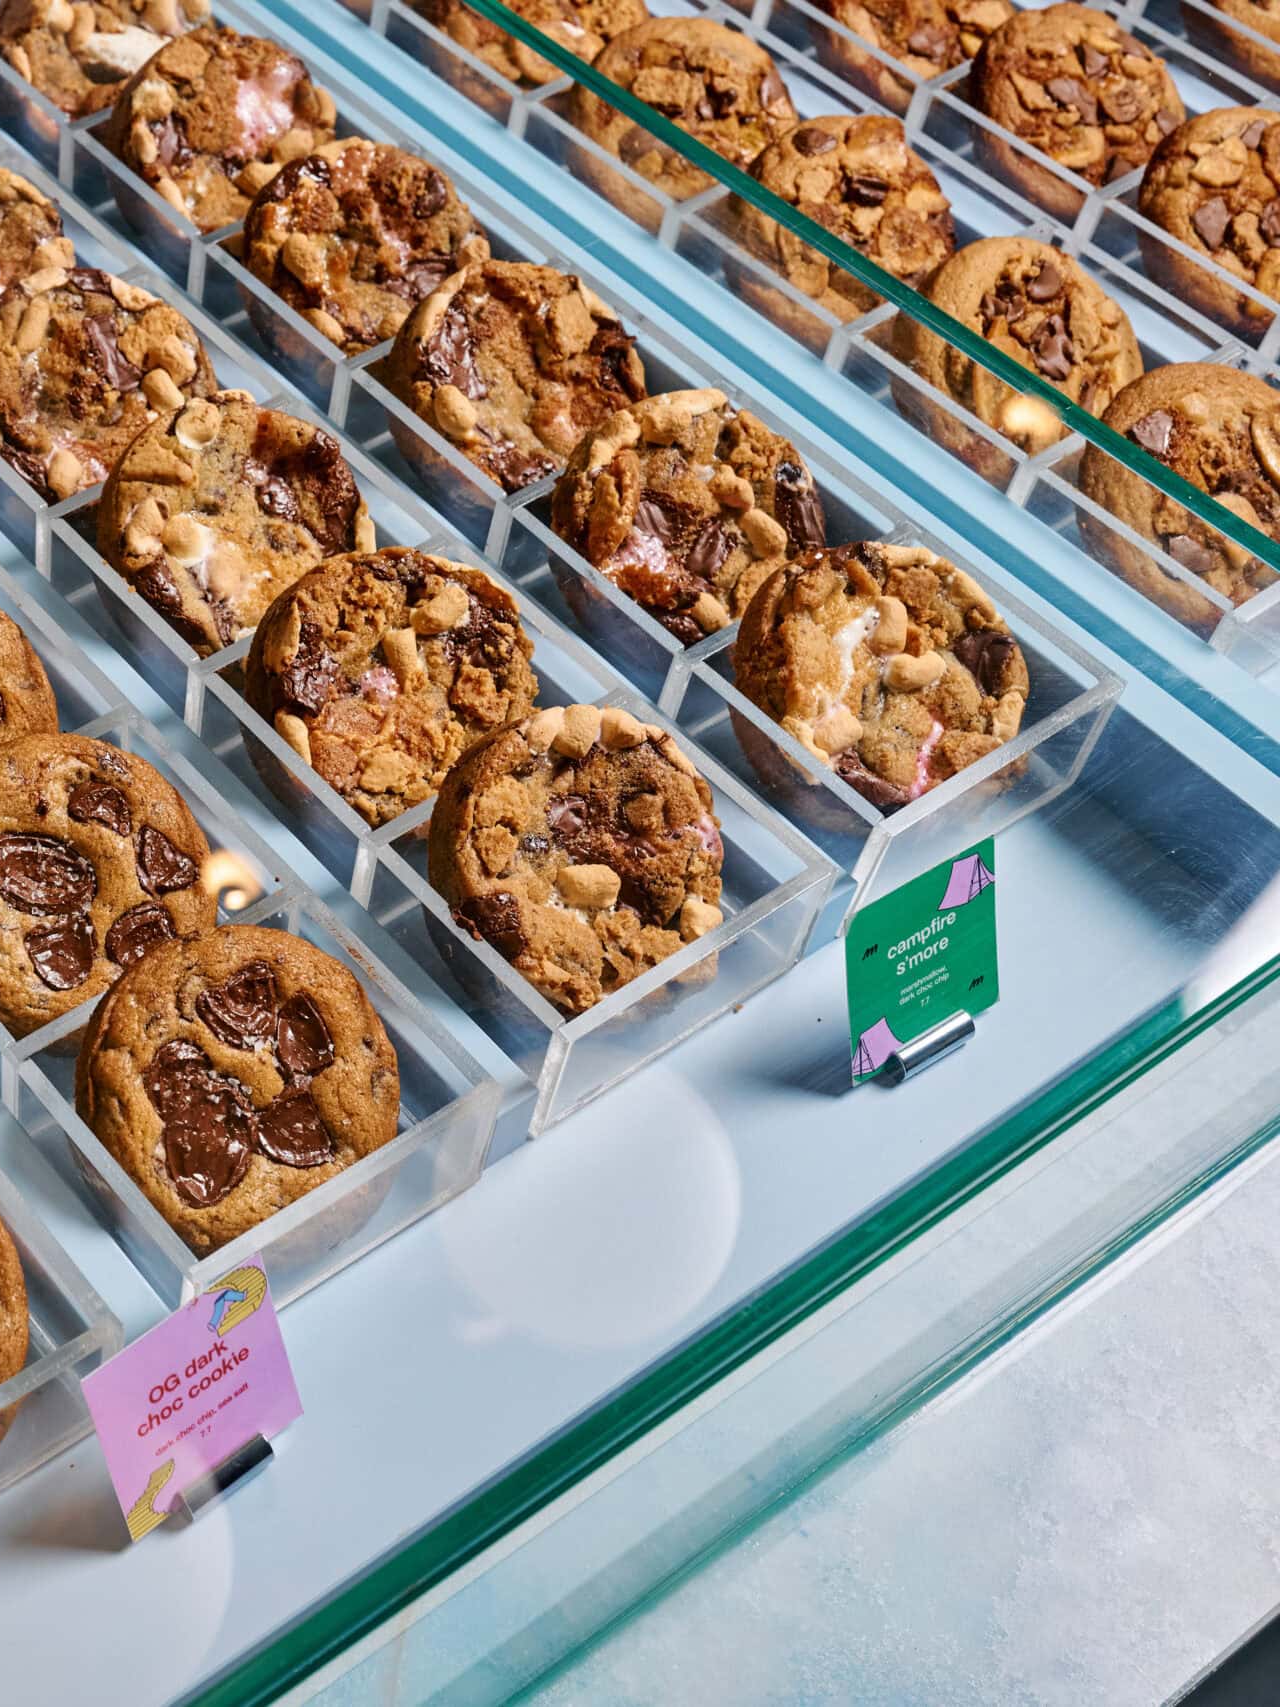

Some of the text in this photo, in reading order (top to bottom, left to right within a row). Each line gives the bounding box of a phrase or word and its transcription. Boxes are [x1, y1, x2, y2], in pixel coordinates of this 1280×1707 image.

[888, 912, 956, 959] campfire
[896, 937, 949, 976] s'more
[137, 1347, 249, 1437] choc cookie
[148, 1340, 228, 1404] OG dark
